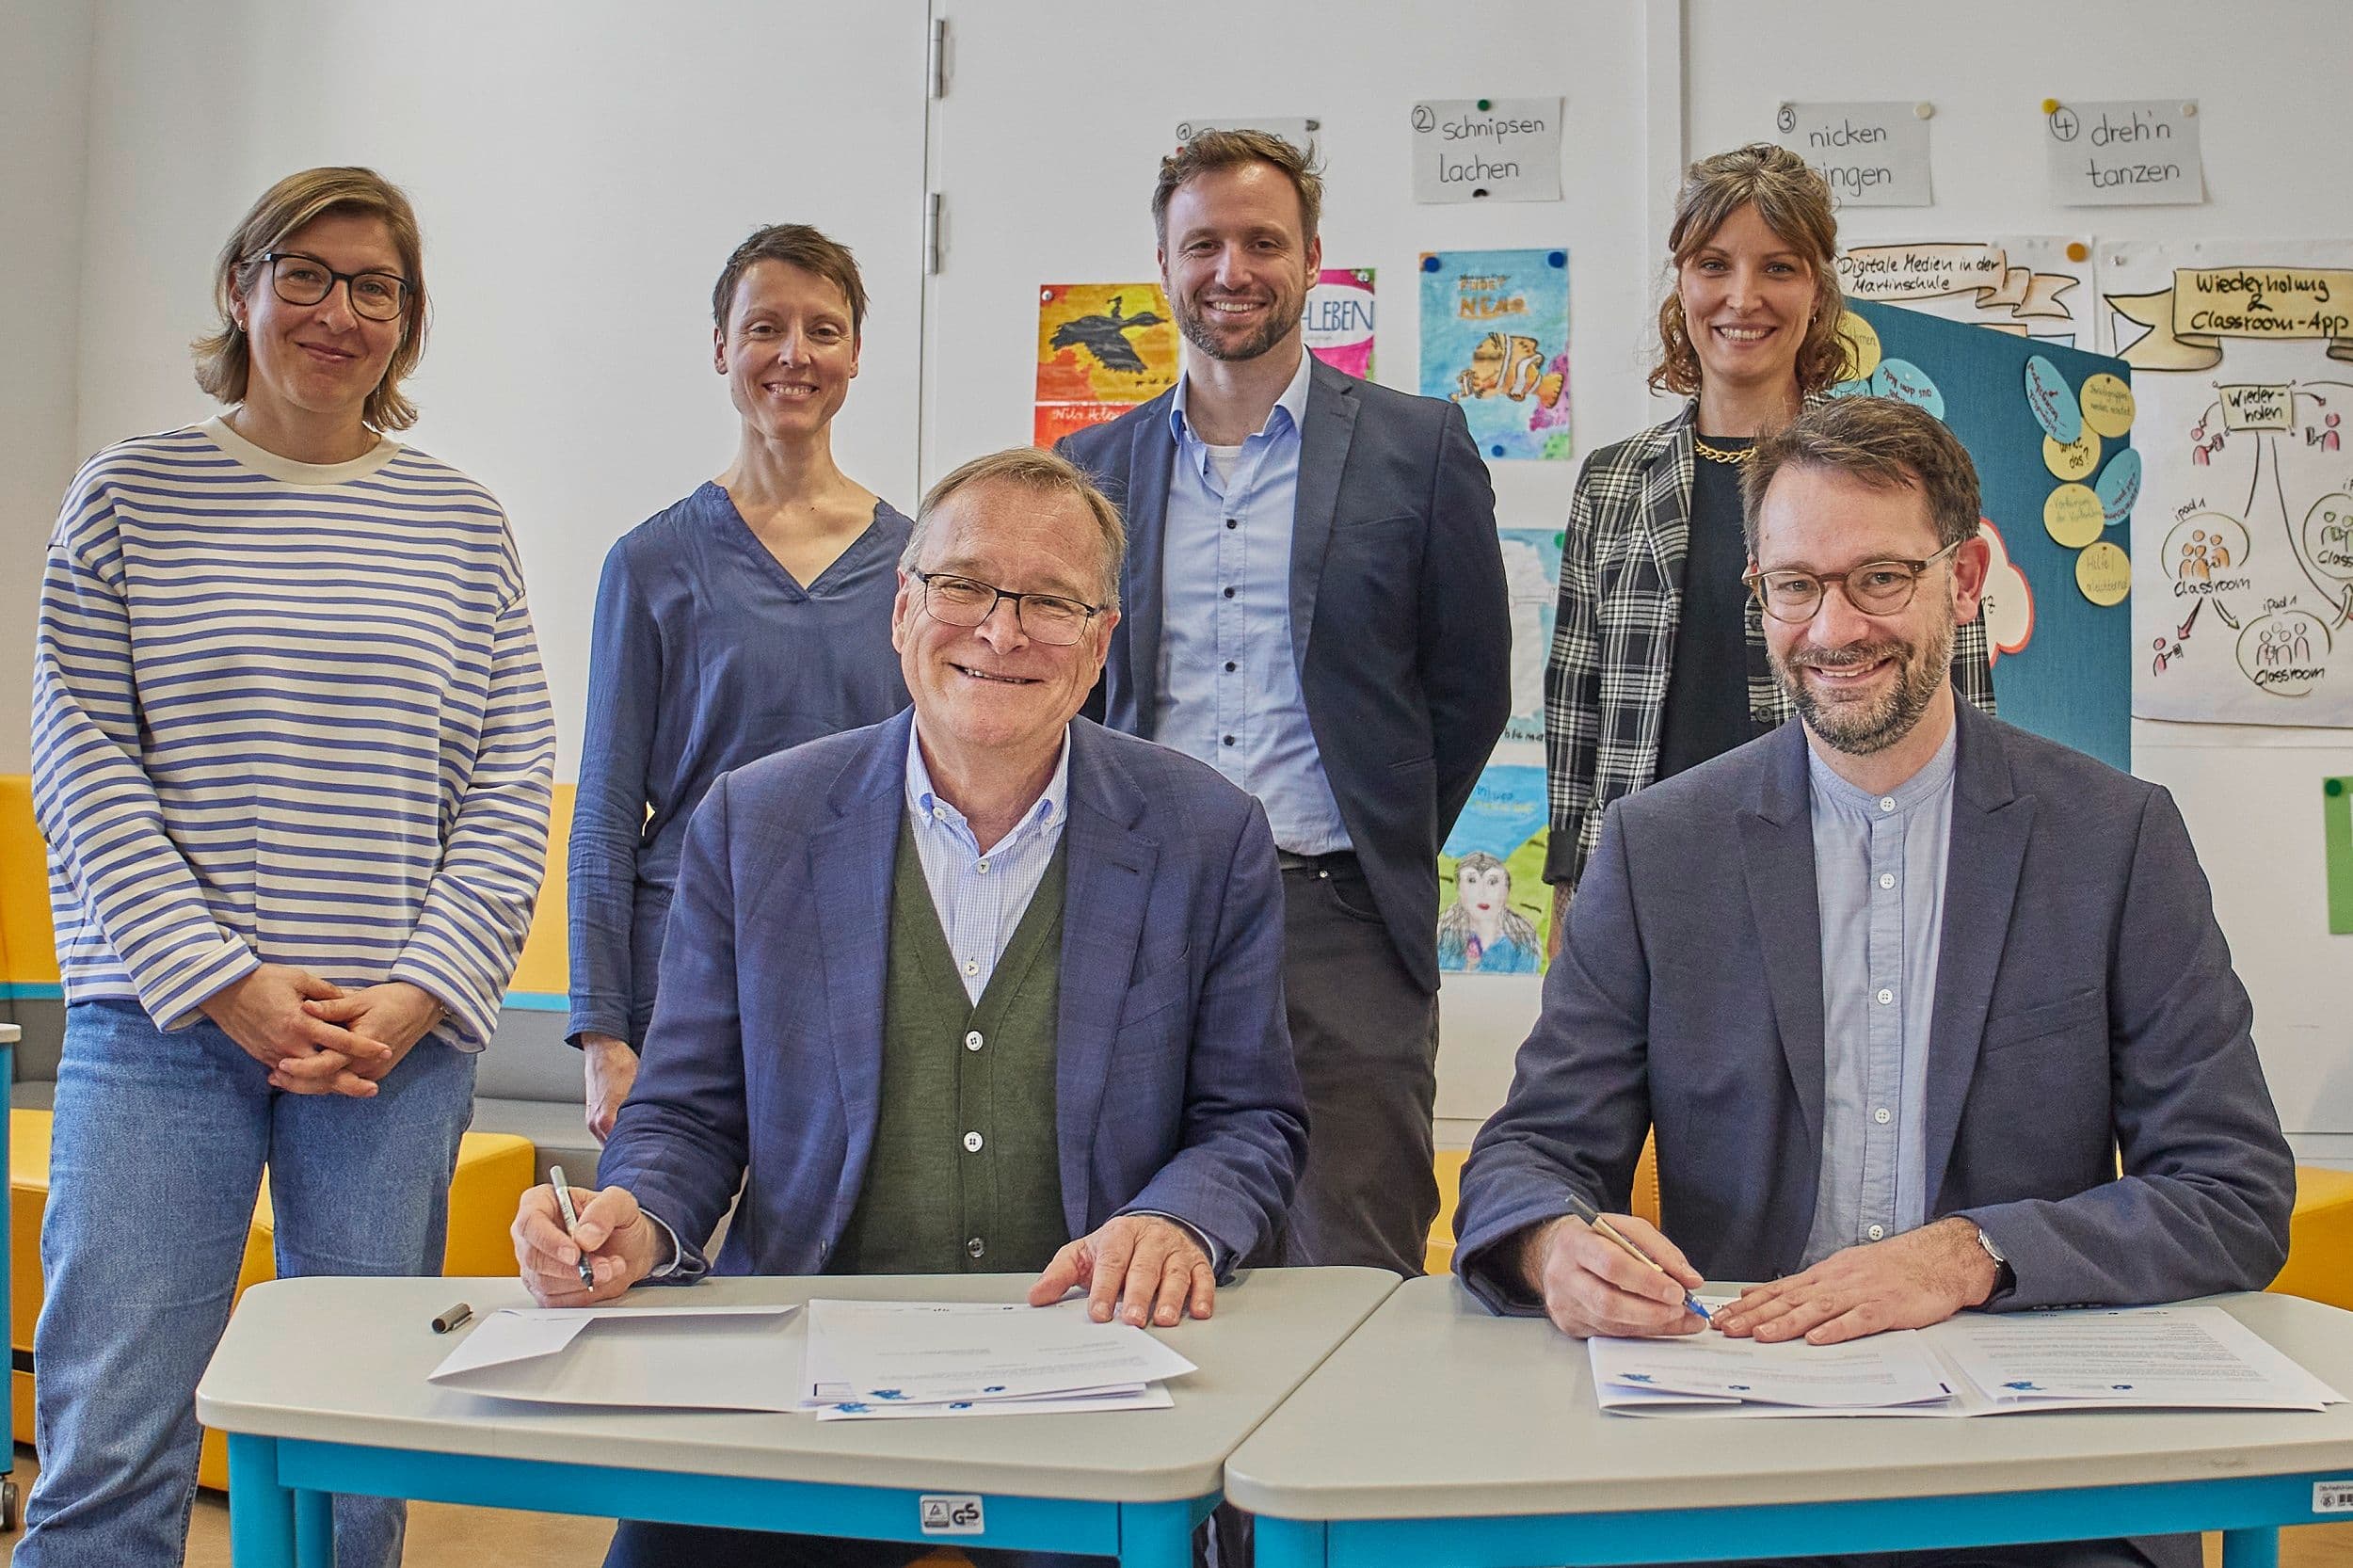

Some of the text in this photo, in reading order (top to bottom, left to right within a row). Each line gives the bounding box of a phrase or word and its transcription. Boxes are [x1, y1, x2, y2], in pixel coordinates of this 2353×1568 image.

[1415, 108, 1545, 144] 2 schnipsen
[1779, 109, 1887, 147] 3 nicken
[2052, 108, 2170, 147] 4 dreh'n
[1439, 153, 1520, 183] lachen
[1815, 162, 1892, 197] ingen
[2086, 158, 2180, 188] tanzen
[1840, 253, 2001, 278] Digitale Medien in der
[1852, 275, 1950, 294] Martinschule
[2196, 271, 2329, 302] Wiederholung
[2247, 293, 2273, 312] &
[2190, 311, 2349, 338] Classroom-App
[2228, 386, 2284, 408] Wieder-
[2244, 405, 2282, 423] holen
[2174, 577, 2251, 597] Classroom
[2254, 666, 2325, 686] Classroom
[952, 1502, 980, 1526] GS
